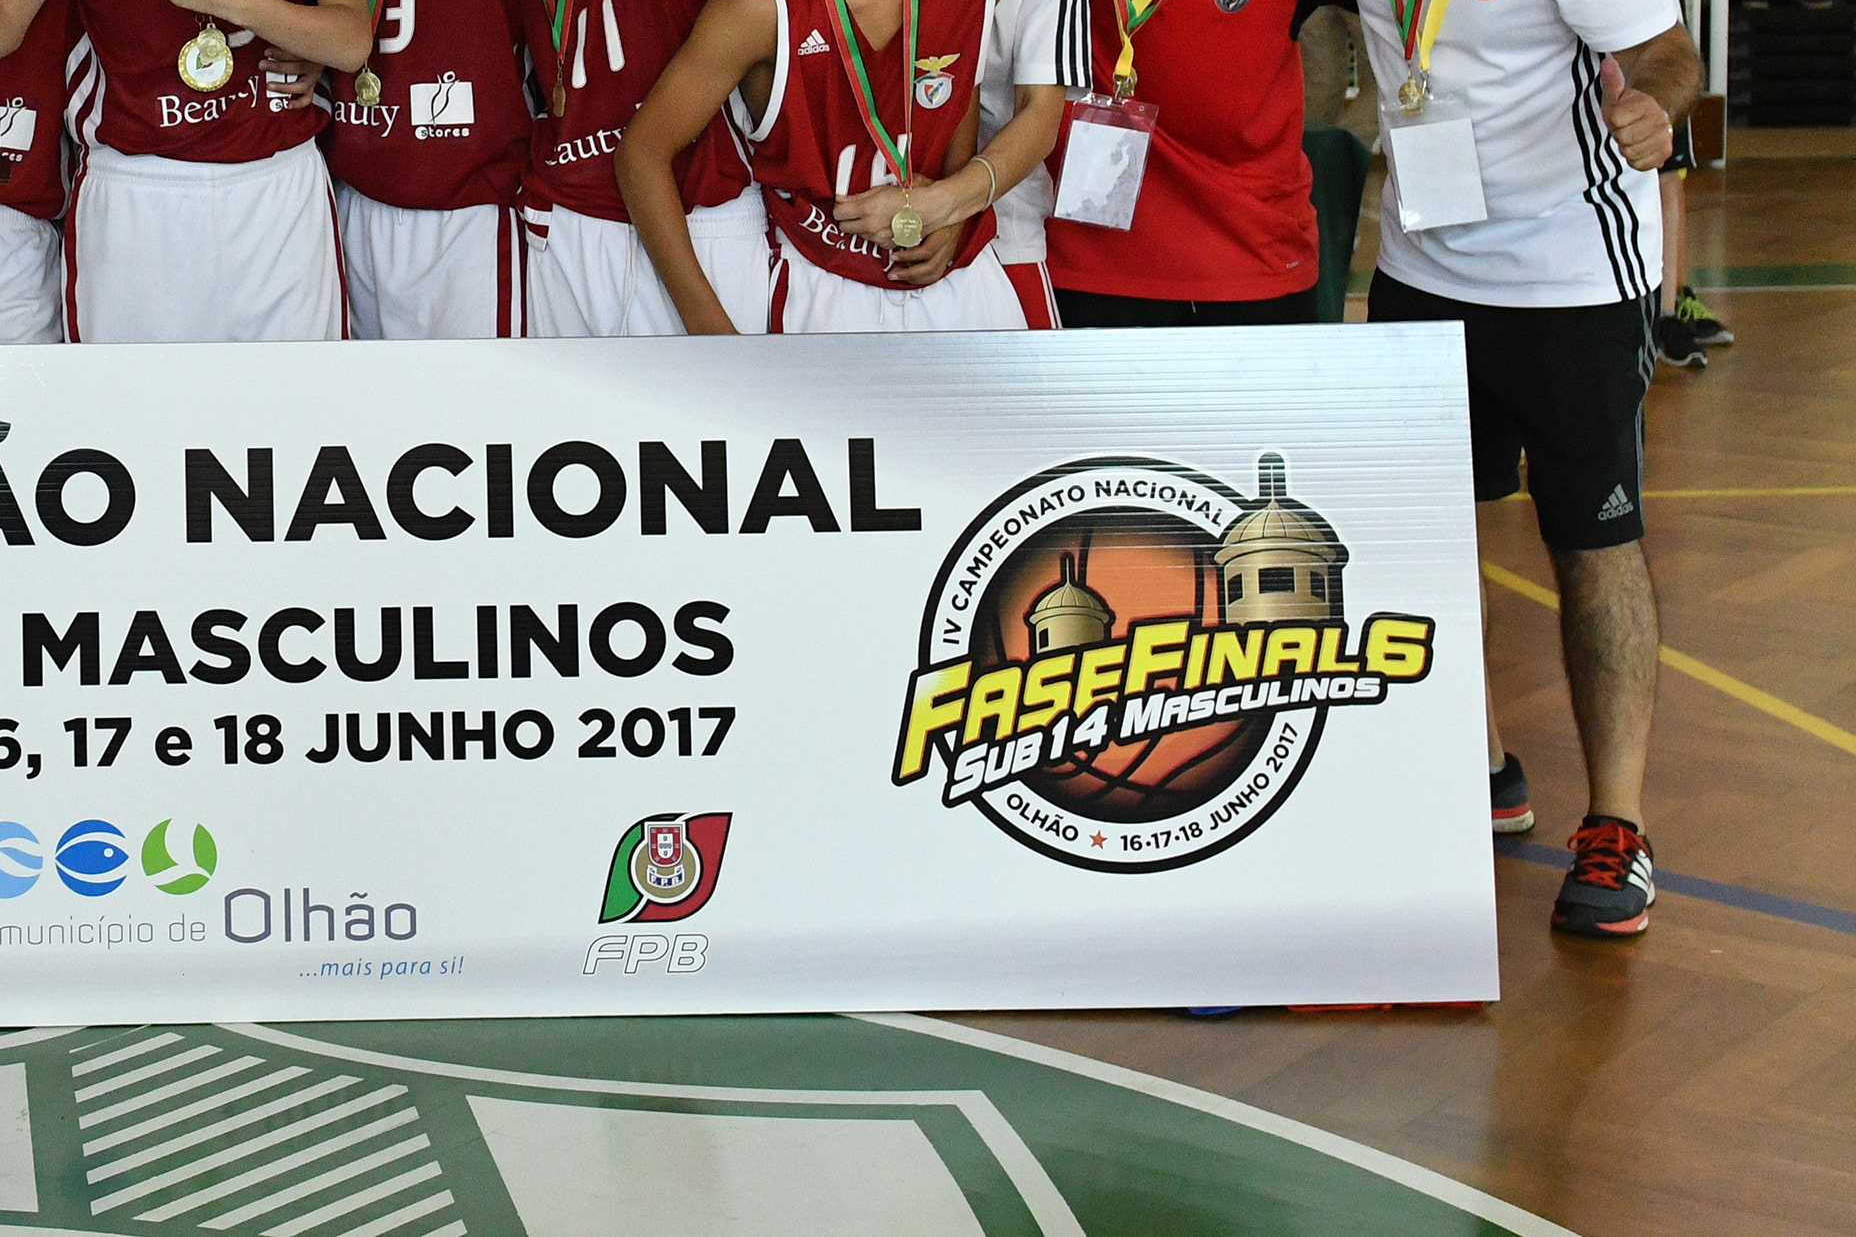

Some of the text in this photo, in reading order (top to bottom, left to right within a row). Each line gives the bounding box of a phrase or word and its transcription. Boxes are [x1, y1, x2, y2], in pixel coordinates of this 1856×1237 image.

[184, 437, 922, 543] NACIONAL
[943, 479, 1224, 646] IV CAMPEONATO NACIONAL
[22, 600, 735, 687] MASCULINOS
[64, 717, 133, 769] 17
[154, 725, 193, 767] e
[214, 715, 284, 766] 18
[305, 709, 555, 765] JUNHO
[577, 706, 736, 759] 2017
[948, 677, 1380, 801] SUB 14 MASCULINOS
[1005, 792, 1080, 843] OLHÃO
[1208, 772, 1270, 831] JUNHO
[1265, 722, 1300, 775] 2017
[168, 914, 206, 943] de
[224, 887, 418, 944] Olhão
[582, 933, 710, 975] FPB
[379, 958, 432, 980] para
[439, 955, 464, 976] si!
